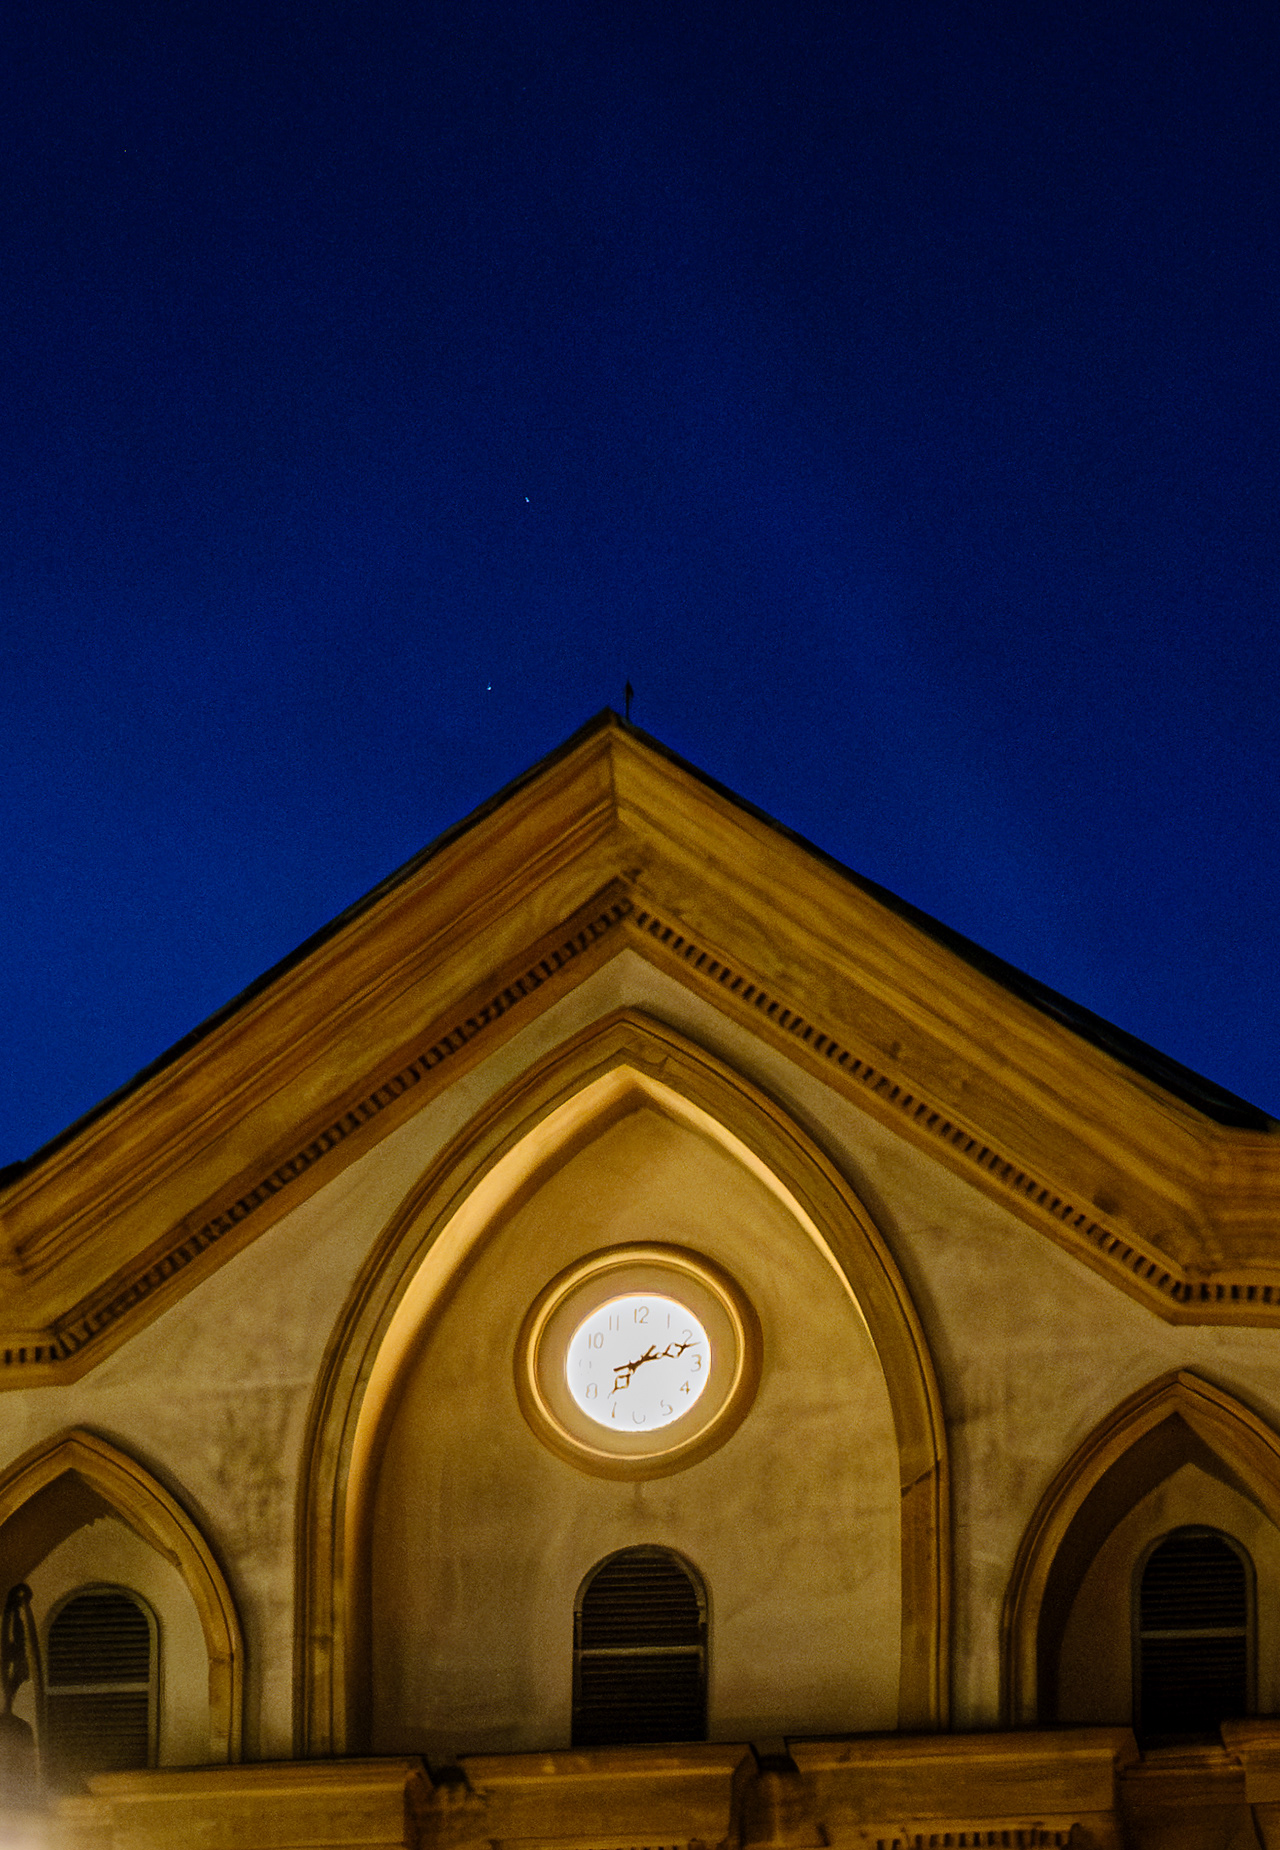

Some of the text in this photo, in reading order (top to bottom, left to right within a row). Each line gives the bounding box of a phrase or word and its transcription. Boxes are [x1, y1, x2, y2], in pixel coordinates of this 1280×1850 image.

[608, 1315, 620, 1332] 11
[633, 1305, 650, 1324] 12
[587, 1331, 605, 1349] 10
[690, 1354, 702, 1372] 3
[679, 1380, 691, 1395] 4
